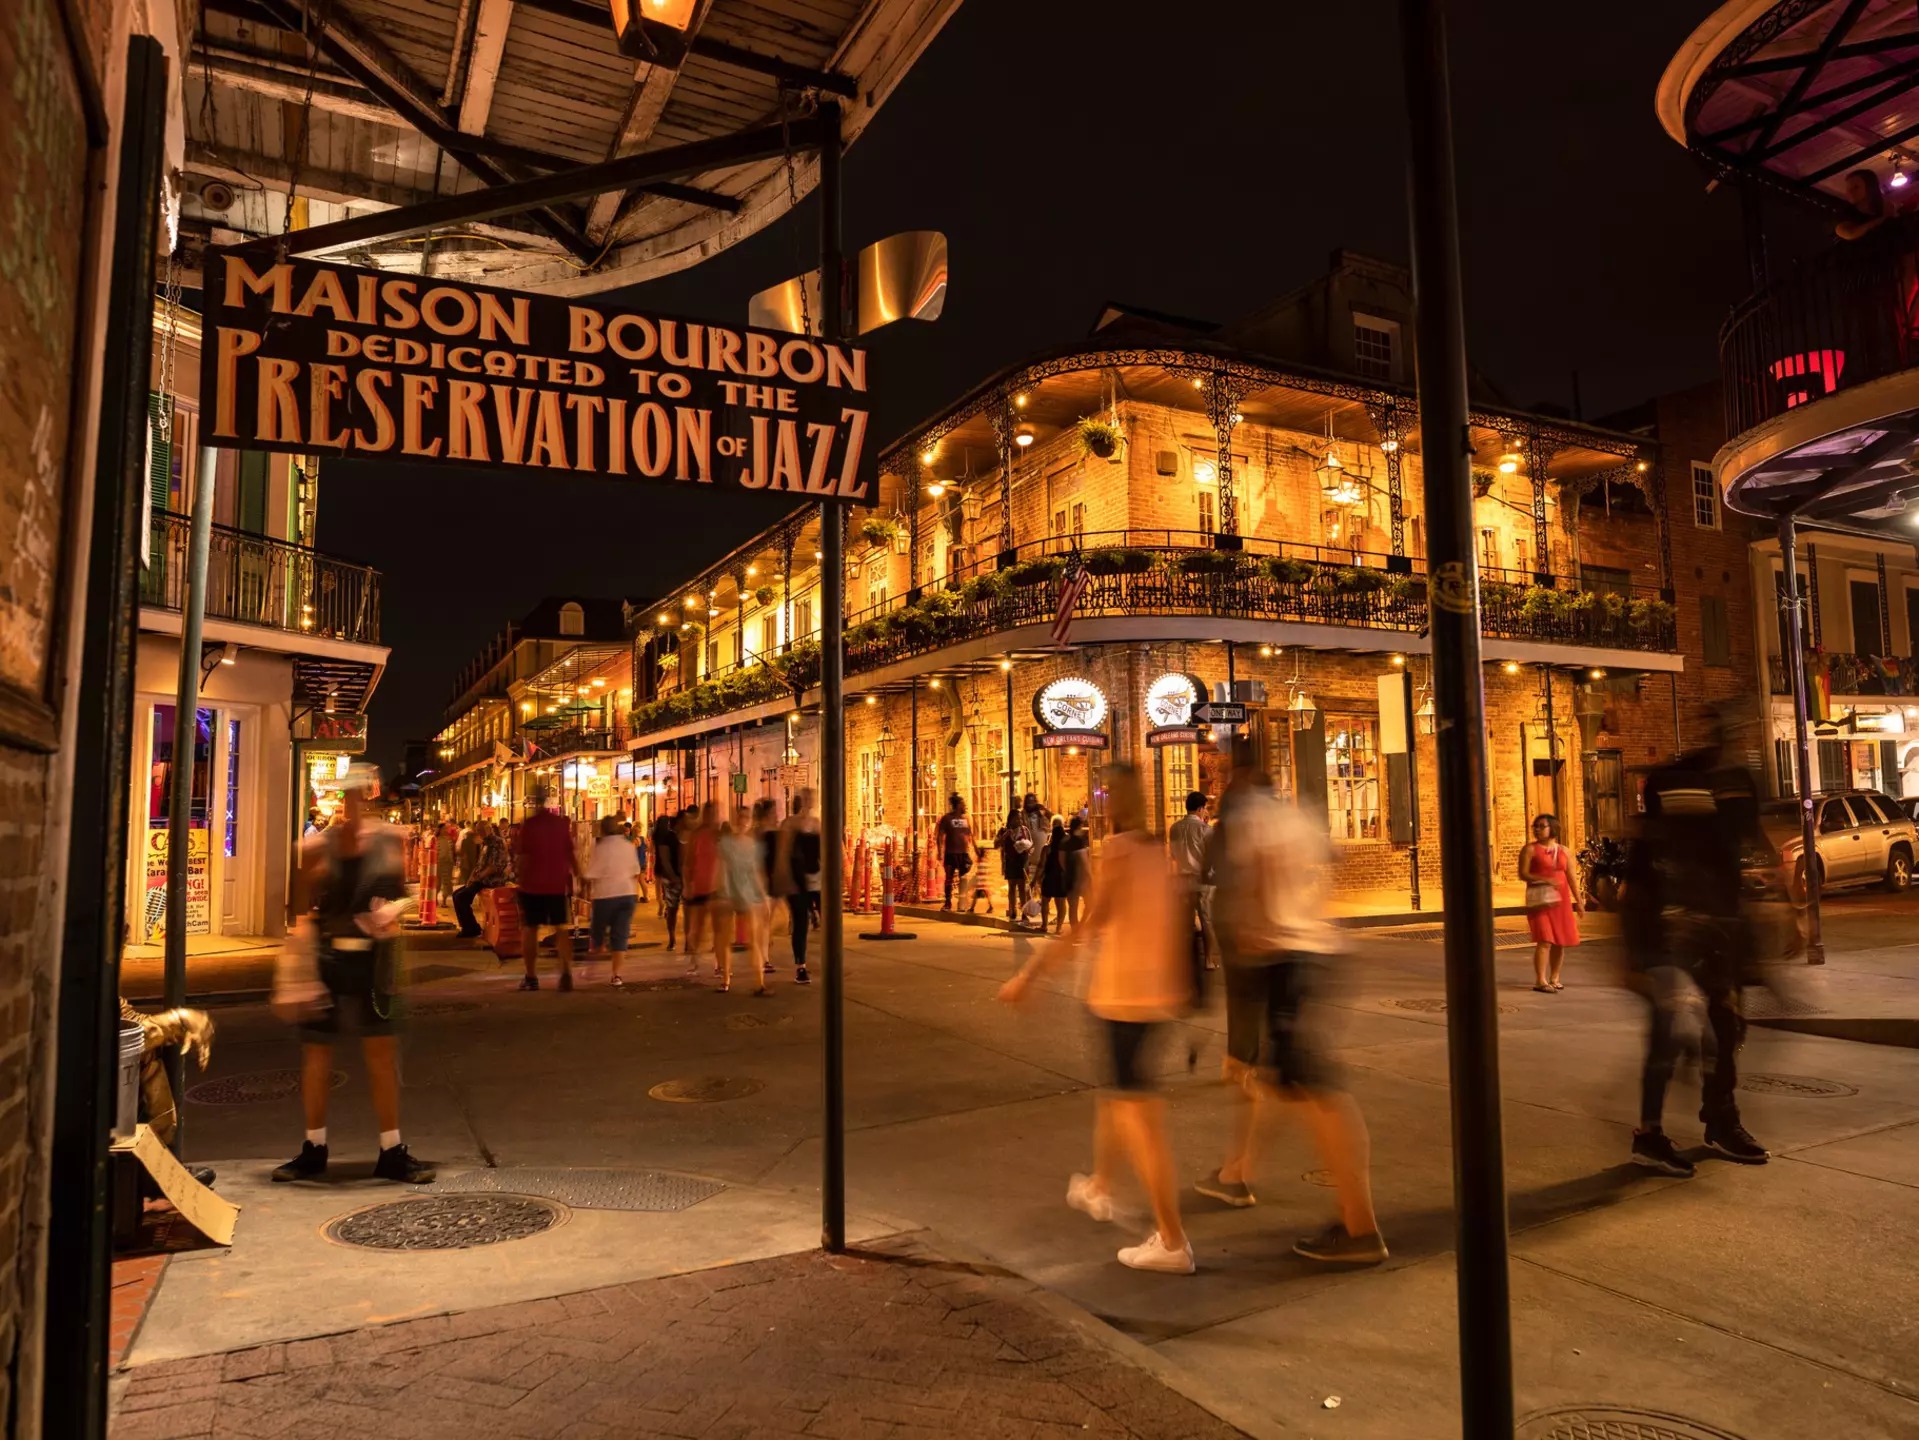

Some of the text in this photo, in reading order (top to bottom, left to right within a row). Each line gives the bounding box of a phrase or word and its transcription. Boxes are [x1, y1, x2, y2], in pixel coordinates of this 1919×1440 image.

[222, 255, 868, 393] MAISON BOURBON
[326, 329, 798, 412] DEDICATED TO THE
[212, 325, 870, 499] PRESERVATION OF JAZZ
[1057, 702, 1086, 719] CORNET
[1161, 700, 1183, 716] CORNET
[1211, 708, 1241, 717] ONE WAY
[1042, 735, 1054, 745] NEW
[188, 866, 204, 875] Bar
